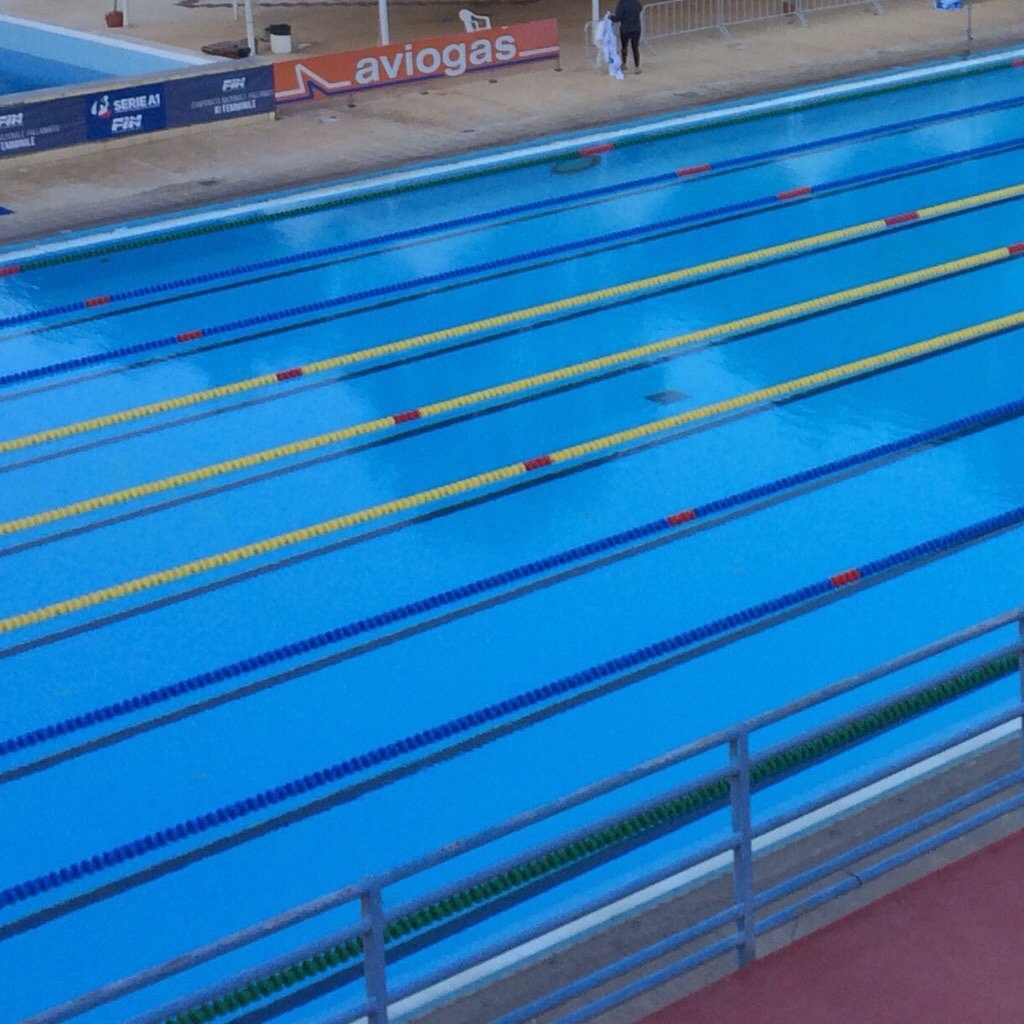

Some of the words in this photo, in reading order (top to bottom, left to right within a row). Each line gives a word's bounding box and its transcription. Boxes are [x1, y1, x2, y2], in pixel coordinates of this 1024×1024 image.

[355, 34, 517, 84] aviogas
[113, 95, 147, 112] SERIE
[147, 93, 161, 107] A1
